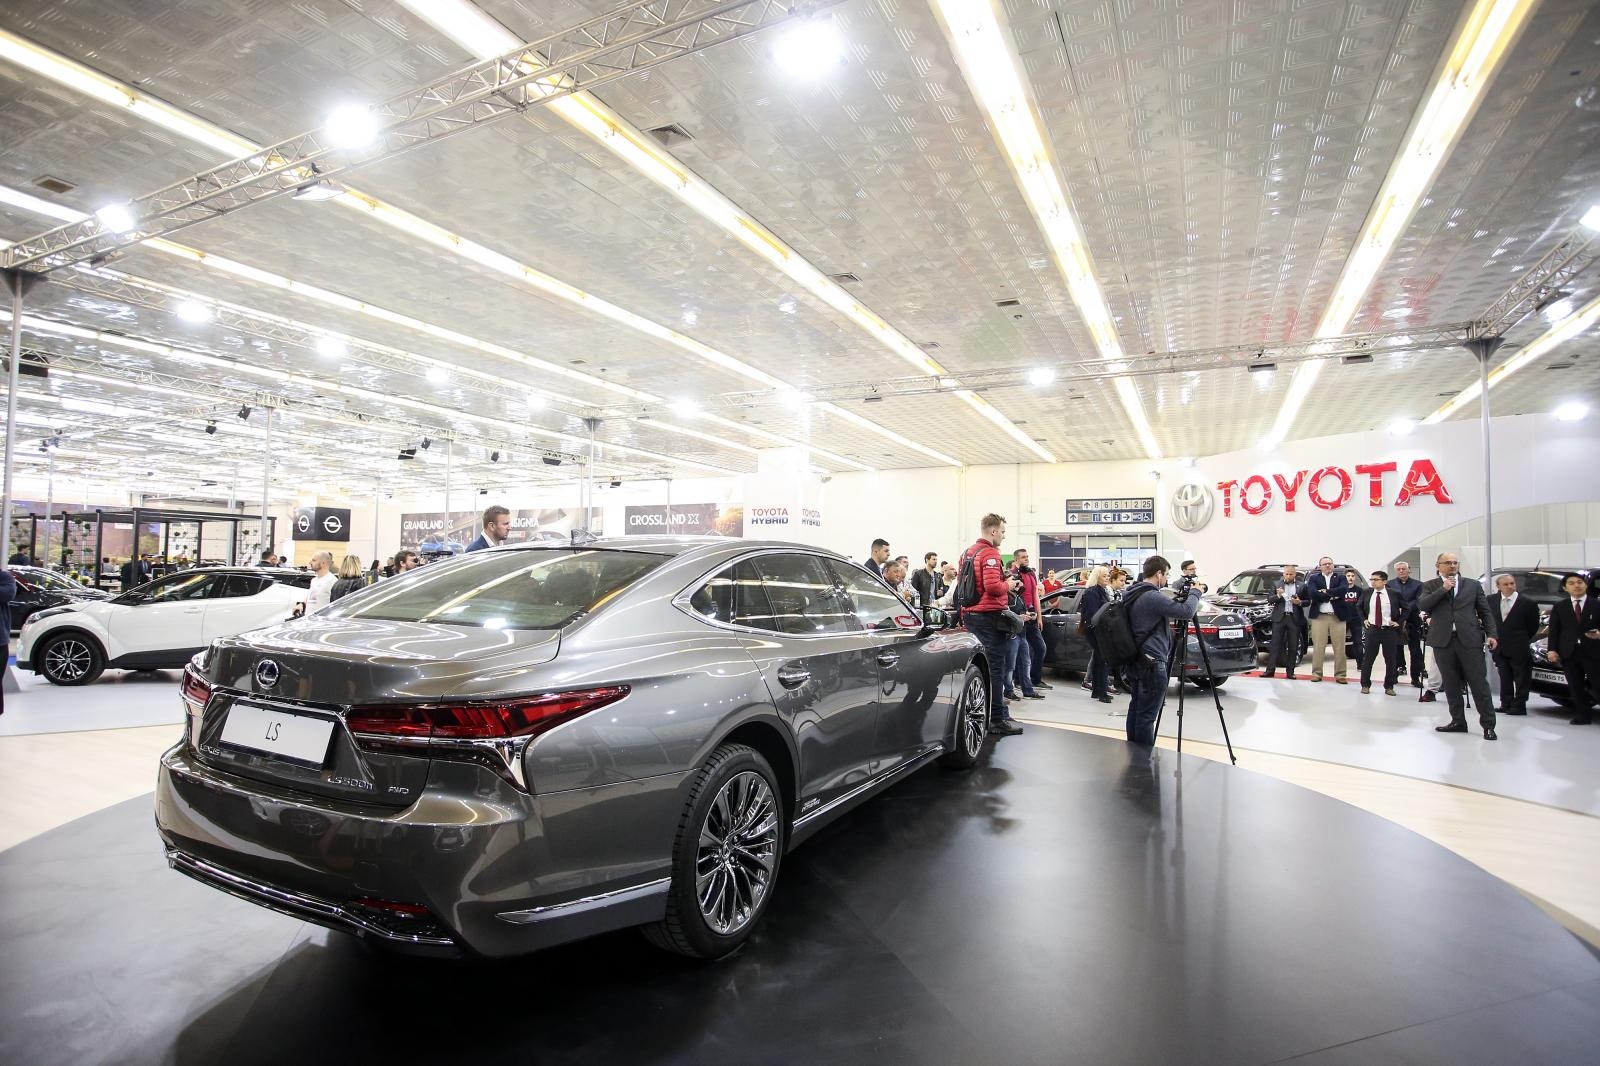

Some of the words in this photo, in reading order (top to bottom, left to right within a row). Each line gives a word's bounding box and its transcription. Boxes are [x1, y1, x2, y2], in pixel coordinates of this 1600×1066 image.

[1216, 459, 1453, 518] TOYOTA
[1104, 501, 1109, 509] 6
[1114, 501, 1119, 509] 5
[1134, 501, 1139, 509] 2
[1142, 501, 1151, 509] 25
[751, 507, 789, 517] TOYOTA
[629, 513, 685, 526] CROSSLAND
[687, 513, 700, 525] X
[751, 517, 789, 525] HYBRID
[403, 520, 444, 530] GRANDLAND
[265, 721, 282, 742] LS
